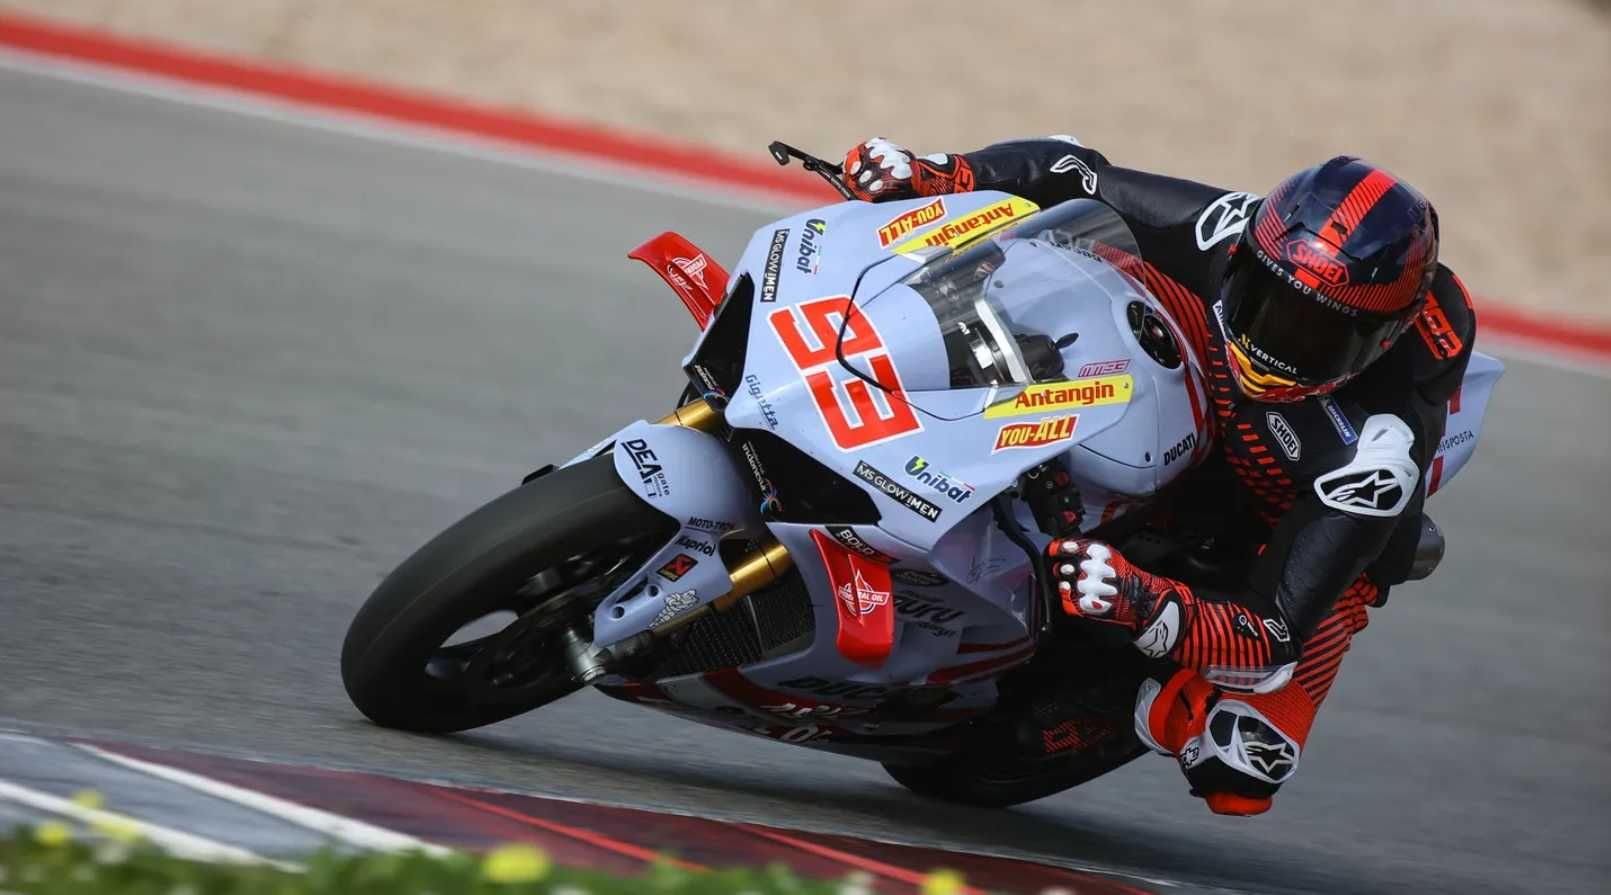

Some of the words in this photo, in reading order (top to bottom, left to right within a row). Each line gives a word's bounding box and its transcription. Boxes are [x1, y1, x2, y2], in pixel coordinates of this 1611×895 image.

[880, 201, 943, 245] YOU-ALL
[925, 203, 1014, 246] Antangin
[796, 219, 827, 273] Unibat
[1257, 250, 1284, 276] GIVES
[1287, 274, 1312, 294] YOU
[769, 296, 924, 451] 93
[1251, 344, 1297, 374] VERTICAL
[1015, 381, 1115, 409] Antangin
[1001, 417, 1072, 446] YOU-ALL
[1163, 433, 1198, 466] DUCATI
[1271, 417, 1298, 455] SHOEI
[857, 465, 874, 480] MS
[874, 476, 907, 500] GLOW
[905, 456, 972, 503] Unibat
